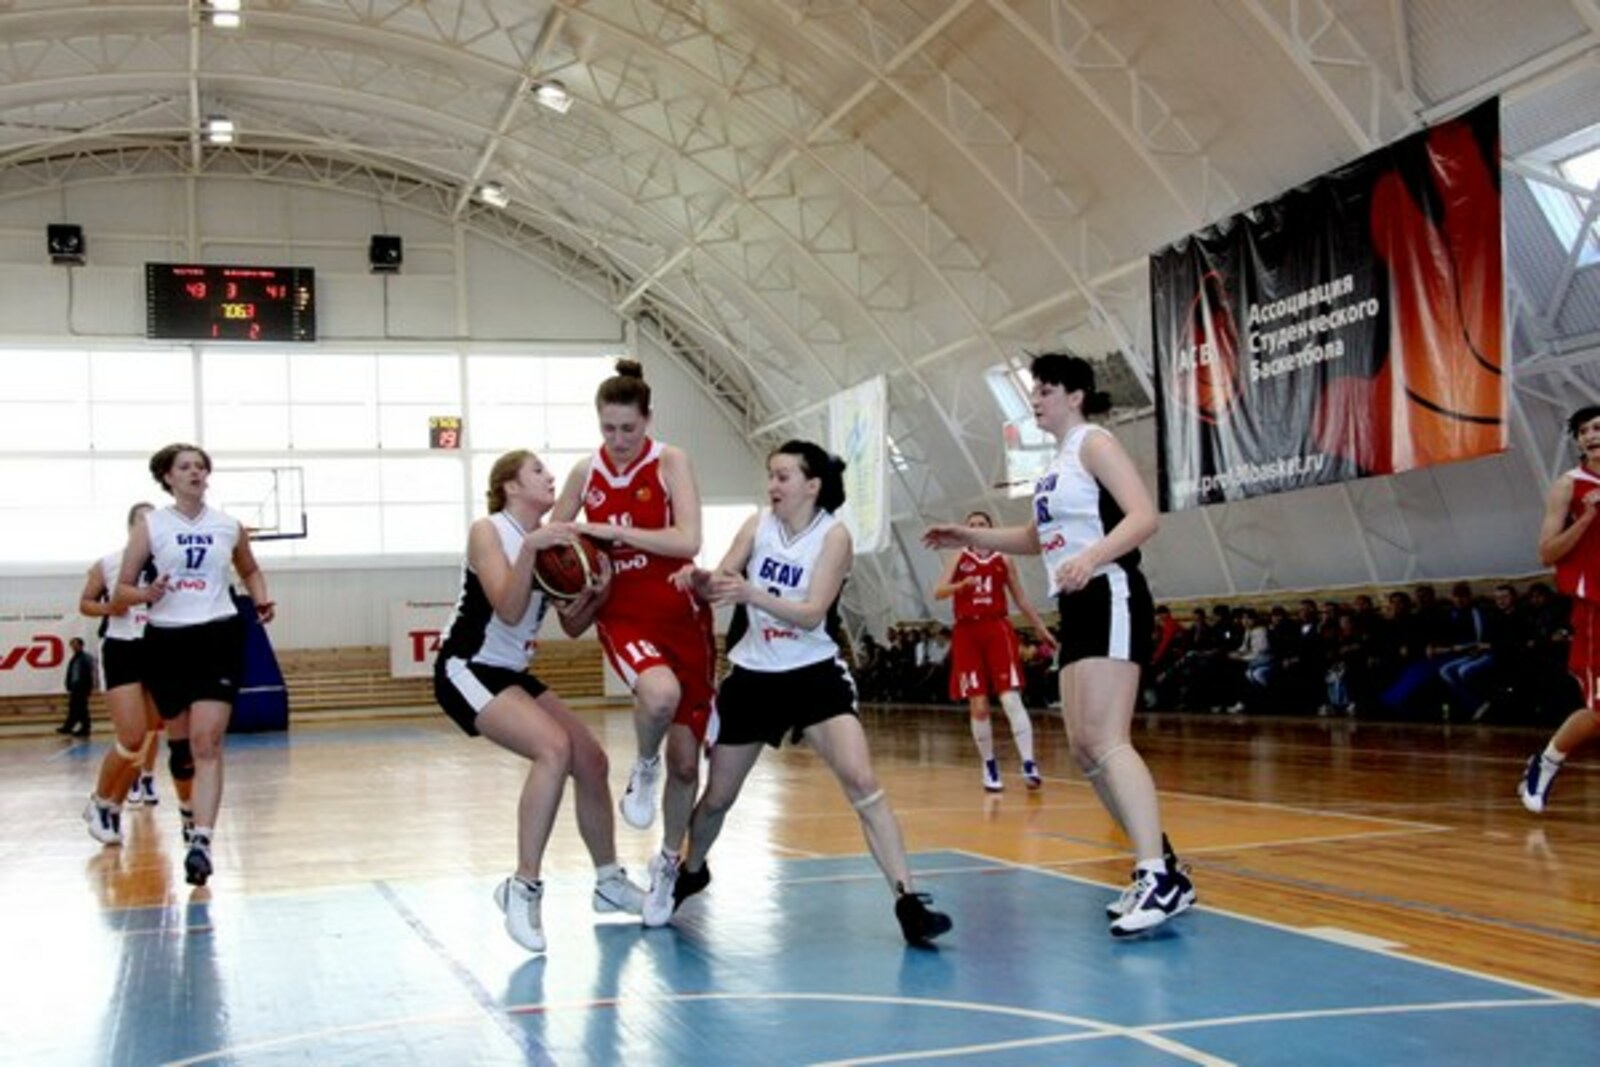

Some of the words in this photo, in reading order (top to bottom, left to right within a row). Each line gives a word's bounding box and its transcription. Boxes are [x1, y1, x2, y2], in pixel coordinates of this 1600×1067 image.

[1248, 274, 1354, 326] Ассоциация
[1248, 298, 1379, 356] Студенческого
[1249, 338, 1345, 382] Баскетбола
[186, 547, 206, 570] 17
[760, 557, 803, 588] БГАУ
